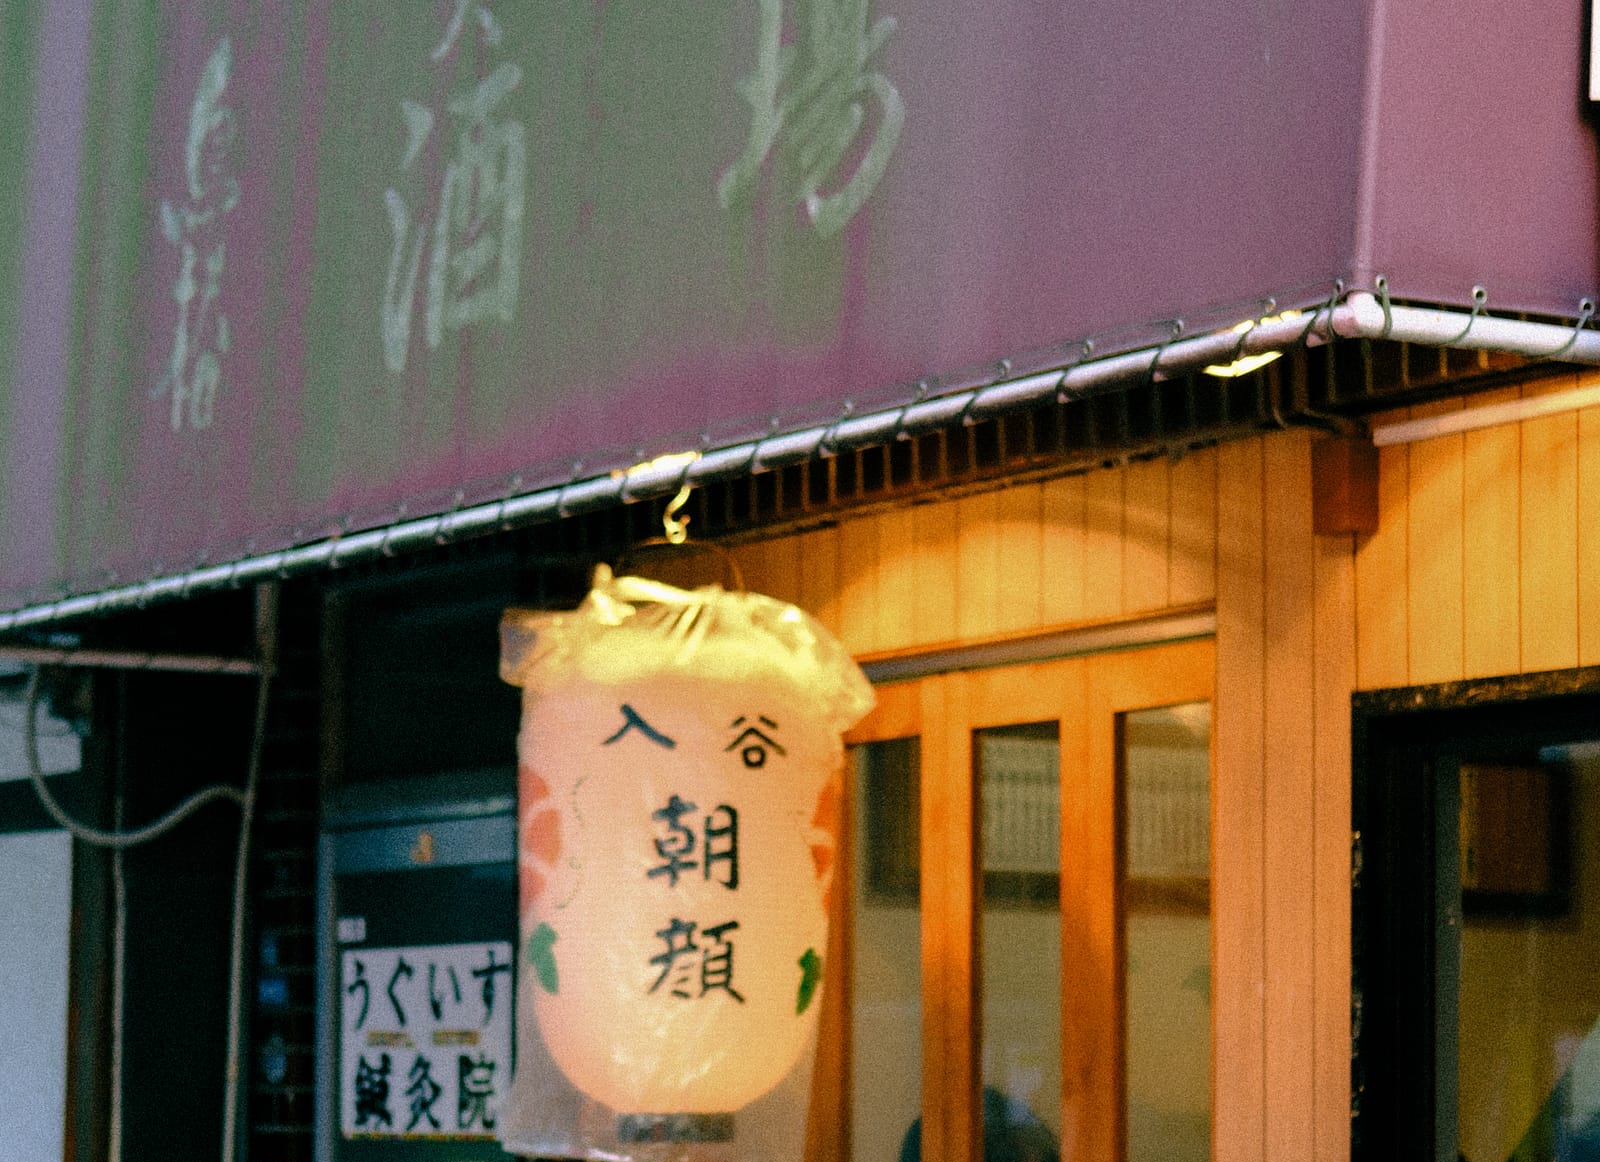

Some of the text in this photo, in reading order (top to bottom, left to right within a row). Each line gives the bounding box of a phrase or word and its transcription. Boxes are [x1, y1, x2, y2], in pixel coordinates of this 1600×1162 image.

[646, 795, 746, 1003] 朝顔
[348, 951, 509, 1030] うぐいす
